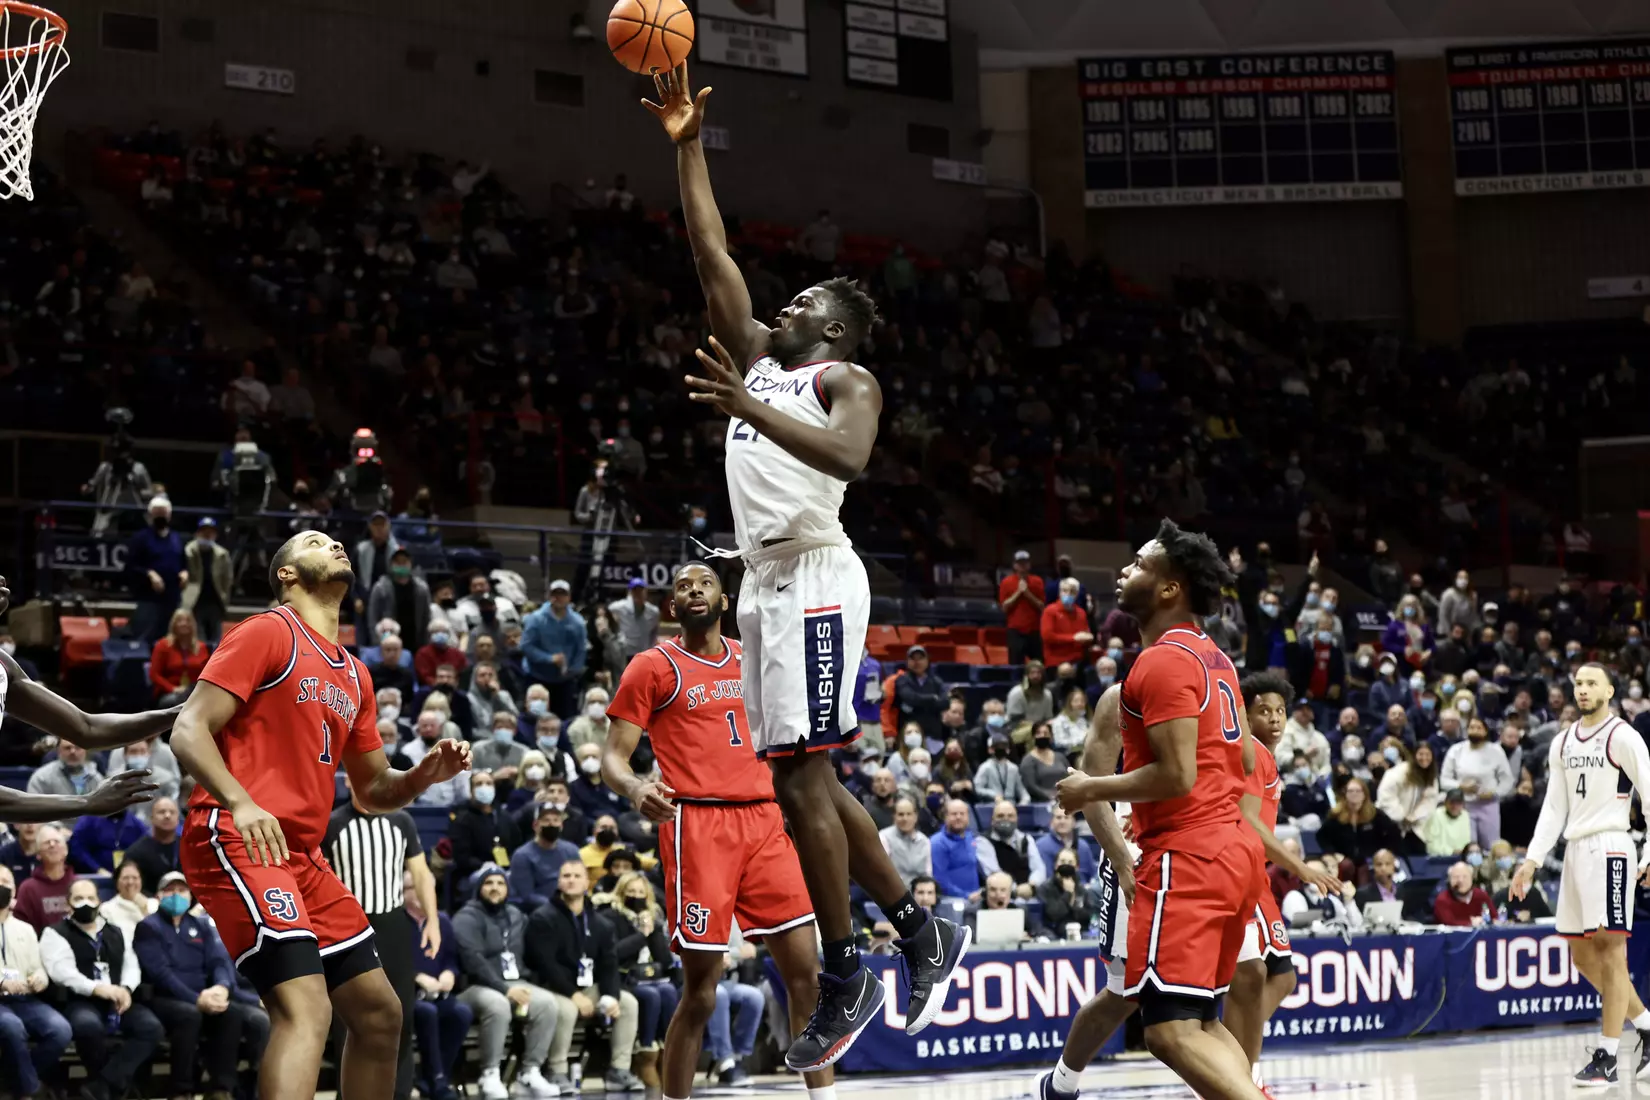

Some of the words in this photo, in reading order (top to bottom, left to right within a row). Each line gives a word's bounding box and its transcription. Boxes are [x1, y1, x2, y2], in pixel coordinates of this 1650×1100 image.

[1084, 61, 1127, 79] BIG
[1140, 59, 1207, 78] EAST
[1220, 55, 1388, 76] CONFERENCE
[1478, 65, 1608, 84] TOURNAMENT
[258, 70, 293, 90] 210
[1086, 81, 1177, 96] REGULAR
[1187, 79, 1263, 93] SEASON
[1273, 76, 1388, 91] CHAMPIONS
[1590, 82, 1623, 105] 1999
[1132, 99, 1166, 122] 1994
[1094, 189, 1214, 206] CONNECTICUT
[1284, 184, 1392, 200] BASKETBALL
[1464, 176, 1584, 192] CONNECTICUT
[55, 545, 89, 562] SEC
[603, 564, 633, 580] SEC
[816, 622, 834, 732] HUSKIES
[686, 684, 711, 711] ST.
[1217, 678, 1242, 743] 0
[725, 710, 743, 747] 1
[318, 719, 332, 765] 1
[1575, 773, 1588, 799] 4
[1100, 857, 1115, 946] HUSKIES
[1612, 860, 1624, 925] HUSKIES
[1278, 946, 1415, 1010] CONN
[1498, 994, 1603, 1017] BASKETBALL
[1262, 1013, 1386, 1038] BASKETBALL
[916, 1030, 1065, 1059] BASKETBALL
